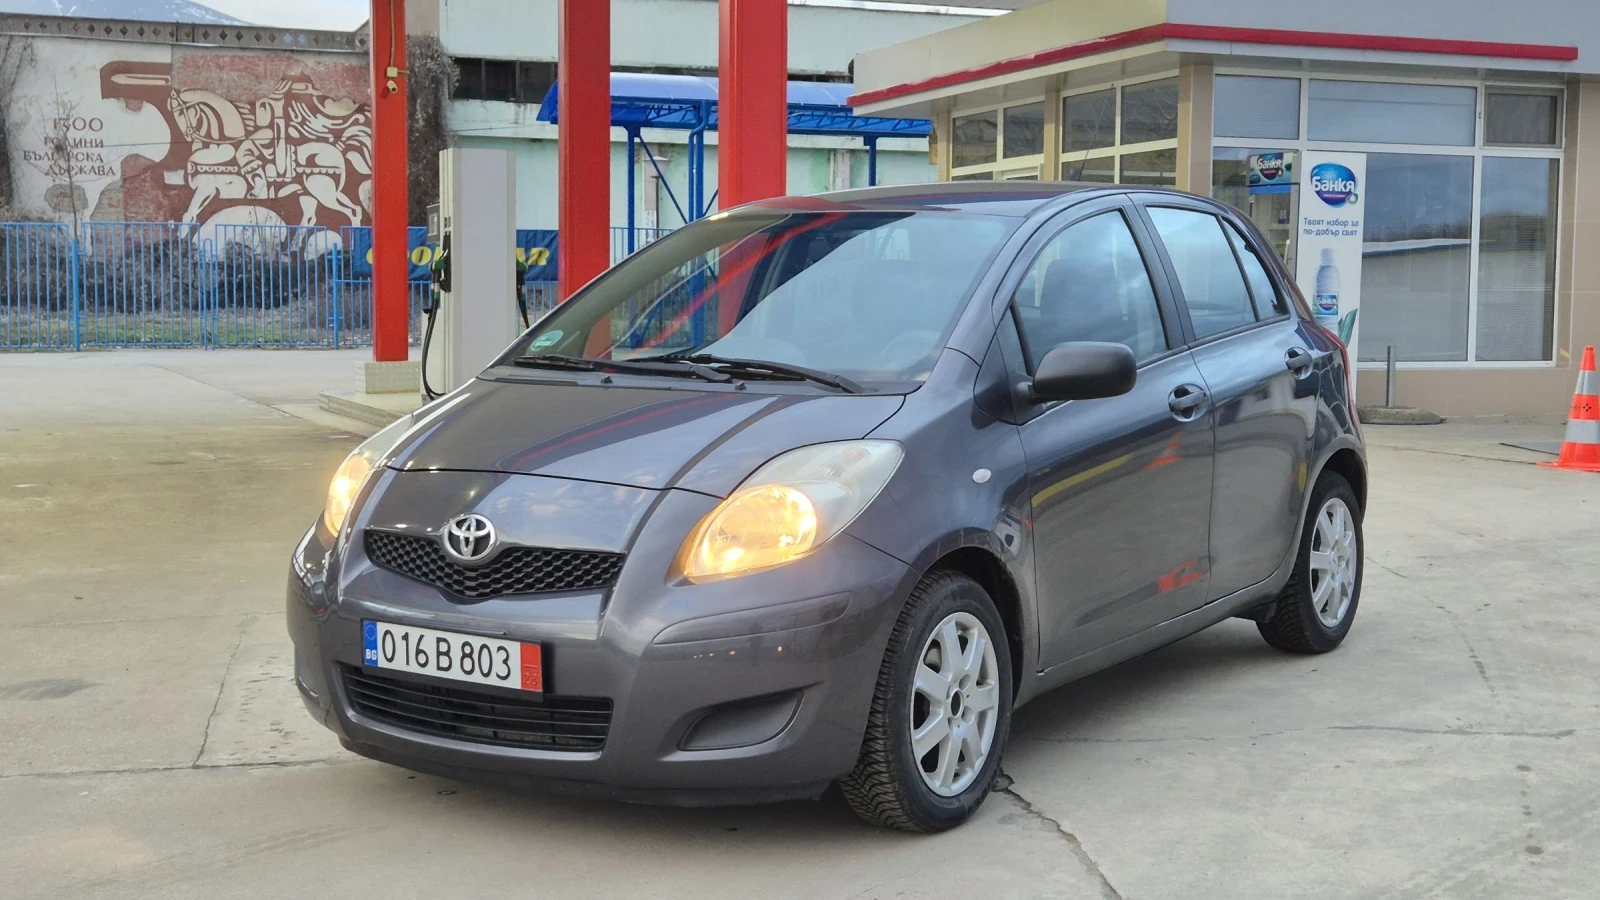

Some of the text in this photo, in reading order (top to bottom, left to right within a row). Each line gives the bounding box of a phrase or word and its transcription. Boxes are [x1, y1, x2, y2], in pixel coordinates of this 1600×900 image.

[1304, 217, 1325, 226] Твоят
[1326, 218, 1349, 228] избор
[1303, 227, 1340, 238] по-добър
[365, 648, 378, 660] BG
